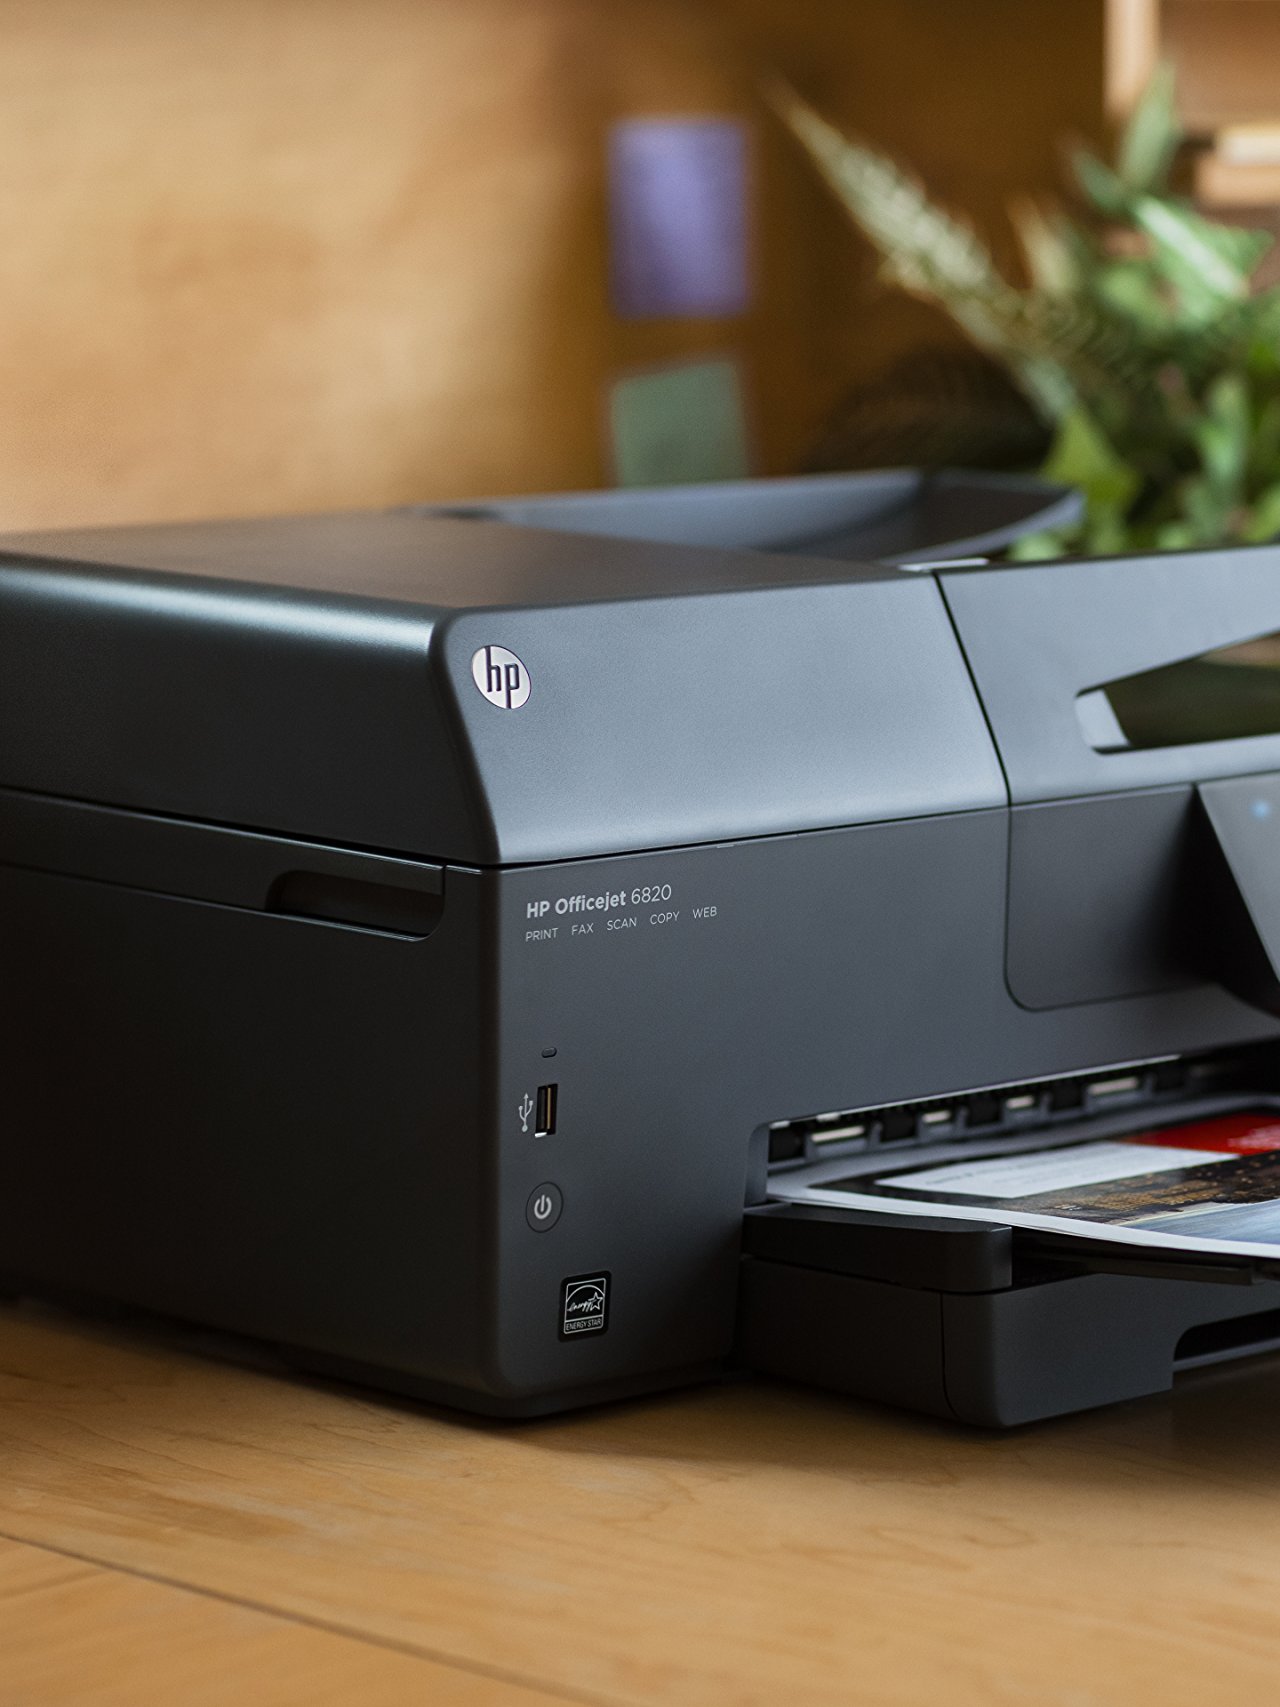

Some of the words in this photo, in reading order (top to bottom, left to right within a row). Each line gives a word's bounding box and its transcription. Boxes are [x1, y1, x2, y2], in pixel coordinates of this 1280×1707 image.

[484, 646, 520, 709] hp
[526, 900, 551, 919] HP
[554, 891, 627, 915] Officejet
[631, 884, 672, 905] 6820
[525, 927, 559, 942] PRINT
[571, 922, 594, 936] FAX
[606, 917, 637, 931] SCAN
[650, 911, 680, 925] COPY
[693, 906, 718, 919] WEB
[566, 1321, 587, 1330] ENERGY
[588, 1318, 601, 1327] STAR
